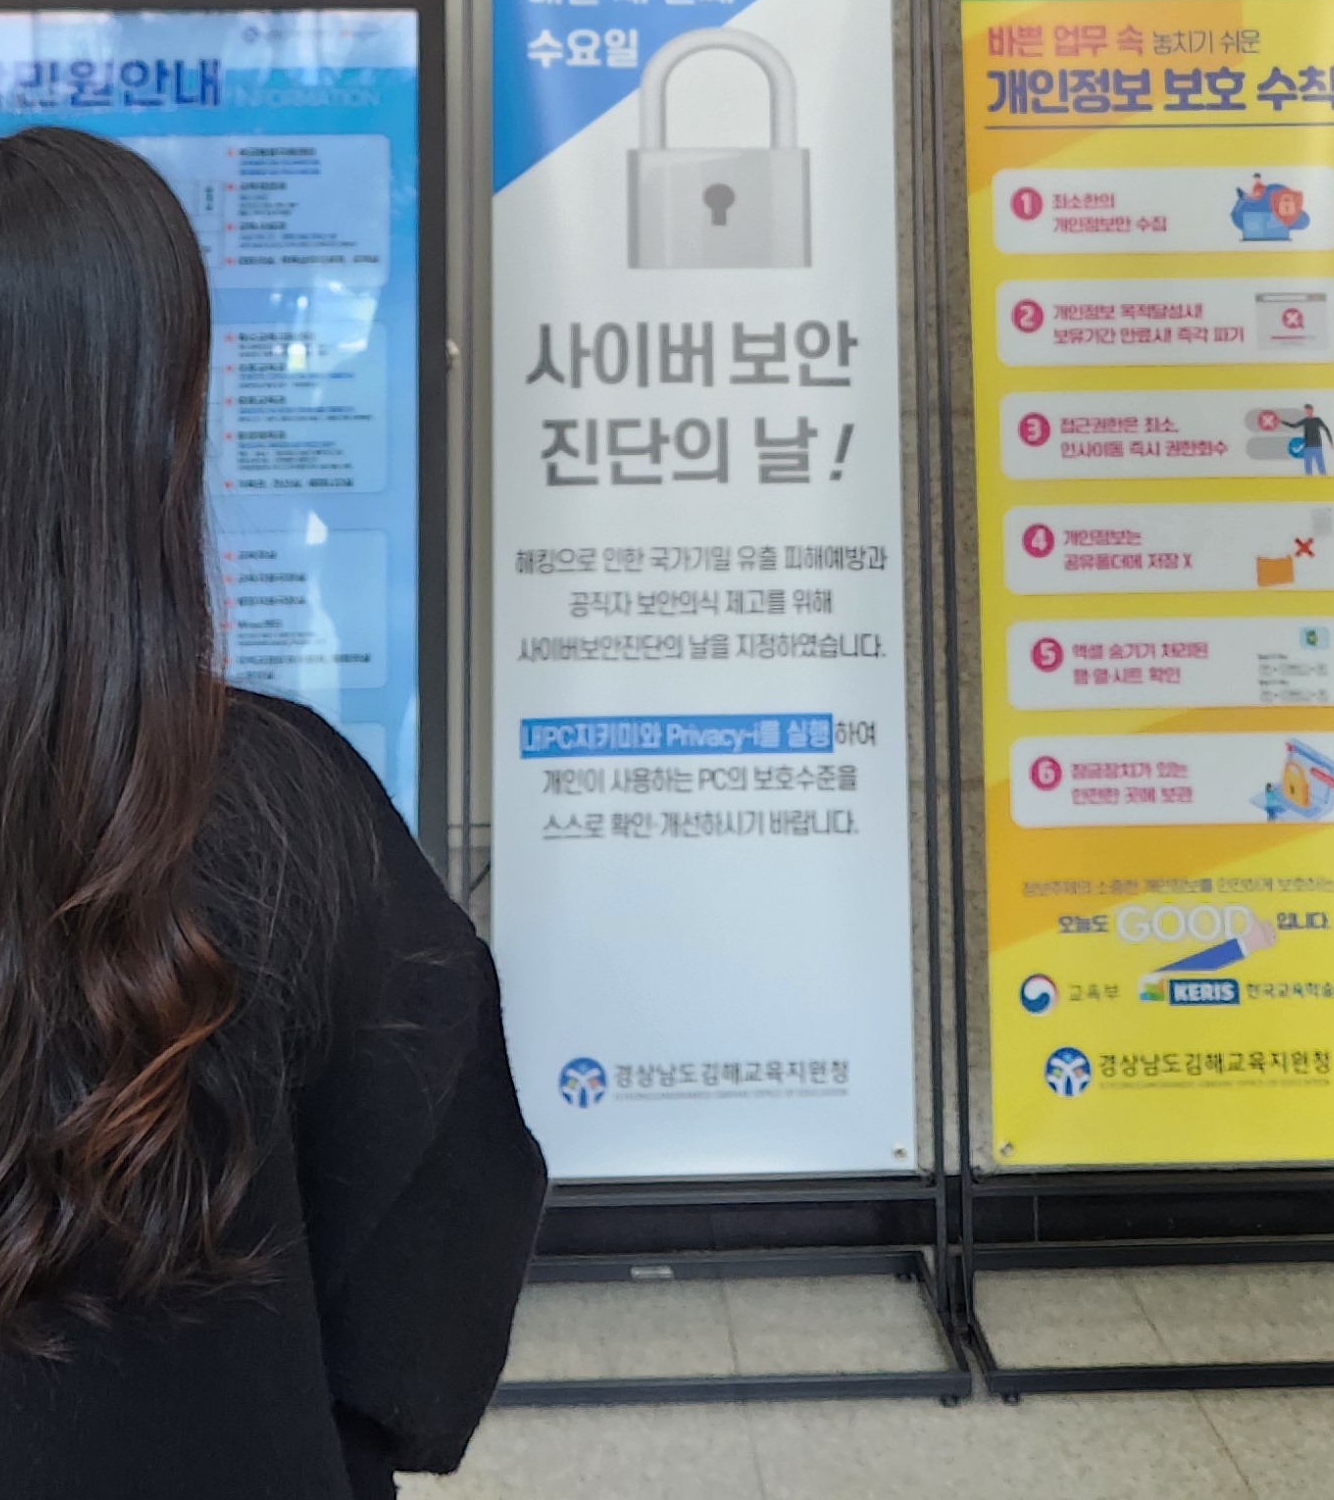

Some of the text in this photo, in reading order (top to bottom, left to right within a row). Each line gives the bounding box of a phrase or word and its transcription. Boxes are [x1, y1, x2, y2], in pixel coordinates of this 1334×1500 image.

[527, 29, 639, 68] 수요일
[987, 24, 1261, 58] 바쁜 업무 속 놓치기 쉬운
[987, 68, 1153, 114] 개인정보
[1163, 67, 1247, 111] 보호
[1020, 192, 1034, 216] 1
[1136, 216, 1168, 232] 수집
[1019, 305, 1036, 329] 2
[1053, 304, 1115, 320] 개인정보
[1053, 328, 1116, 345] 보유기간
[1026, 417, 1043, 442] 3
[541, 417, 729, 487] 진단의
[1129, 440, 1160, 457] 즉시
[1030, 528, 1048, 551] 4
[515, 545, 888, 575] 해킹으로 인한 국가기밀 유출 피해예방과
[569, 588, 833, 617] 공직자 보안의식 제고를 위해
[517, 632, 887, 662] 사이버보안진단의 날을 지정하였습니다.
[1039, 641, 1057, 667] 5
[543, 764, 857, 796] 개인이 사용하는 PC의 보호수준을
[1037, 760, 1055, 787] 6
[542, 812, 605, 840] 스스로
[769, 809, 860, 836] 바랍니다.
[1058, 914, 1109, 934] 오늘도
[1117, 903, 1253, 943] GOOD
[1174, 981, 1235, 1002] KERIS
[615, 1060, 851, 1089] 경상남도김해교육지원청
[1099, 1050, 1331, 1077] 경상남도김해교육지원청
